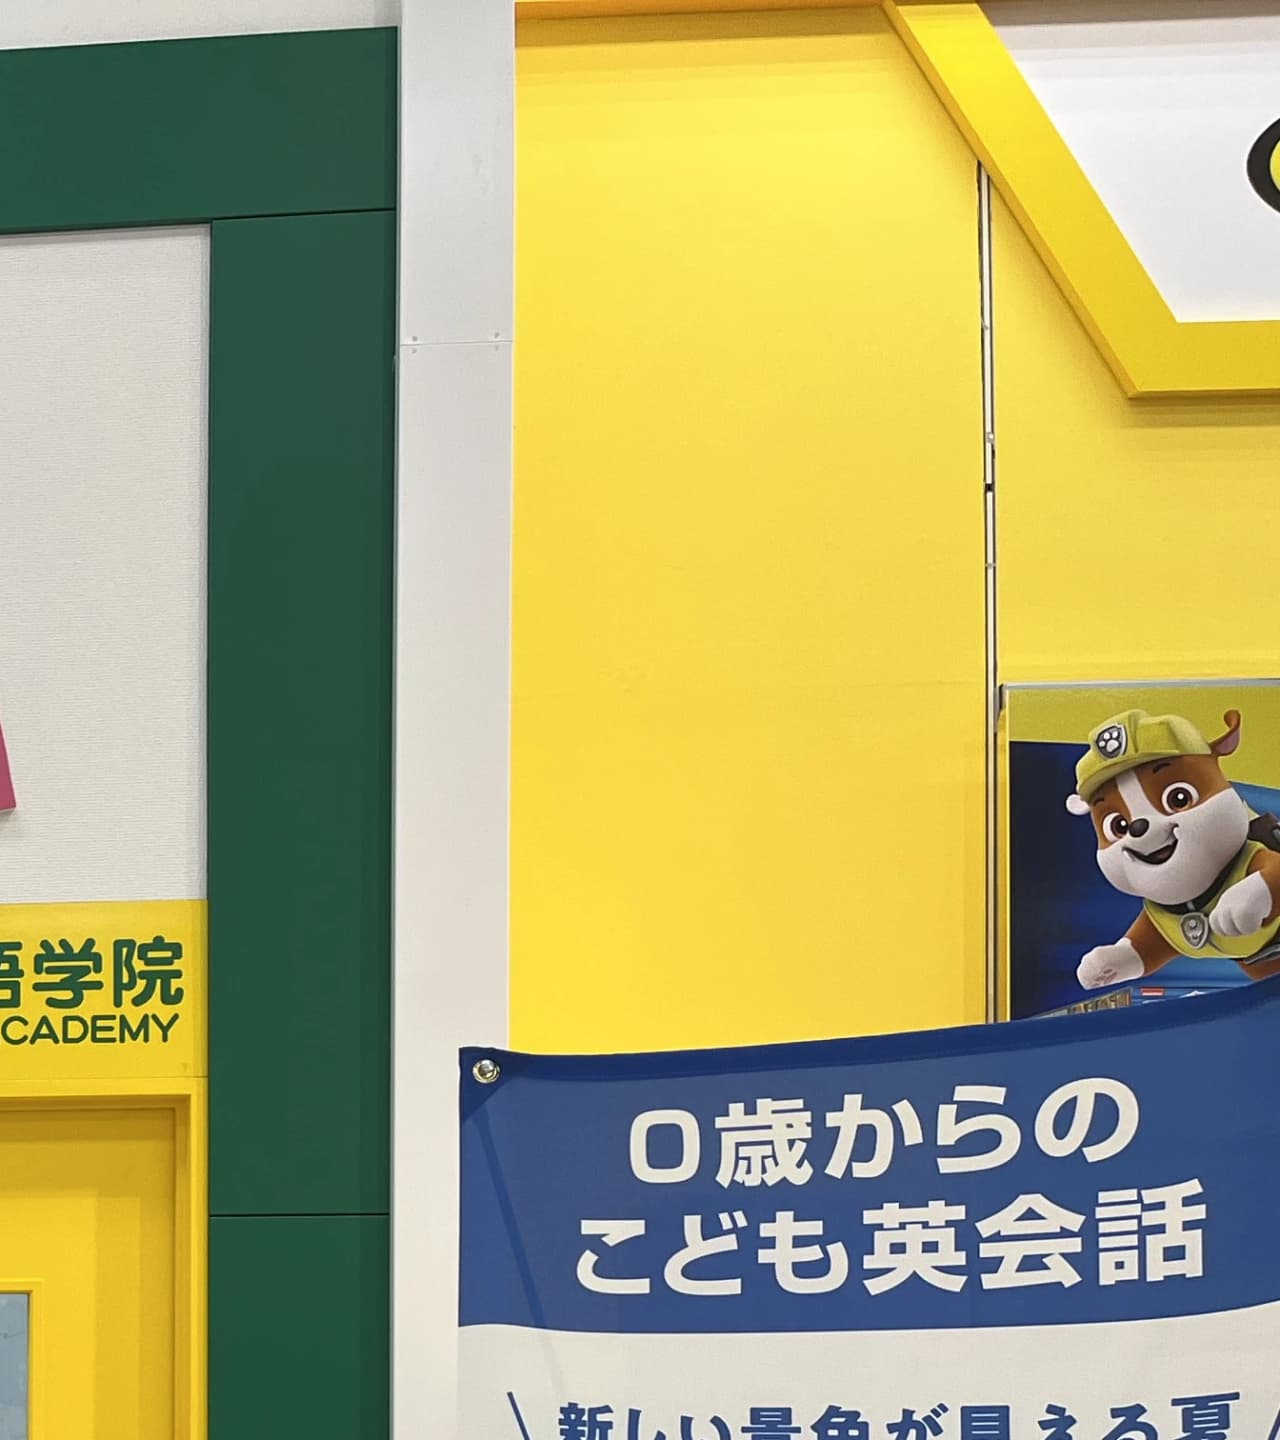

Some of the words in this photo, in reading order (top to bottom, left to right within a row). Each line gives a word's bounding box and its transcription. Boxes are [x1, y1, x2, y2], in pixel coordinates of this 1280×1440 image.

[628, 1076, 1140, 1189] 0歳からの
[576, 1178, 1207, 1297] こども英会話
